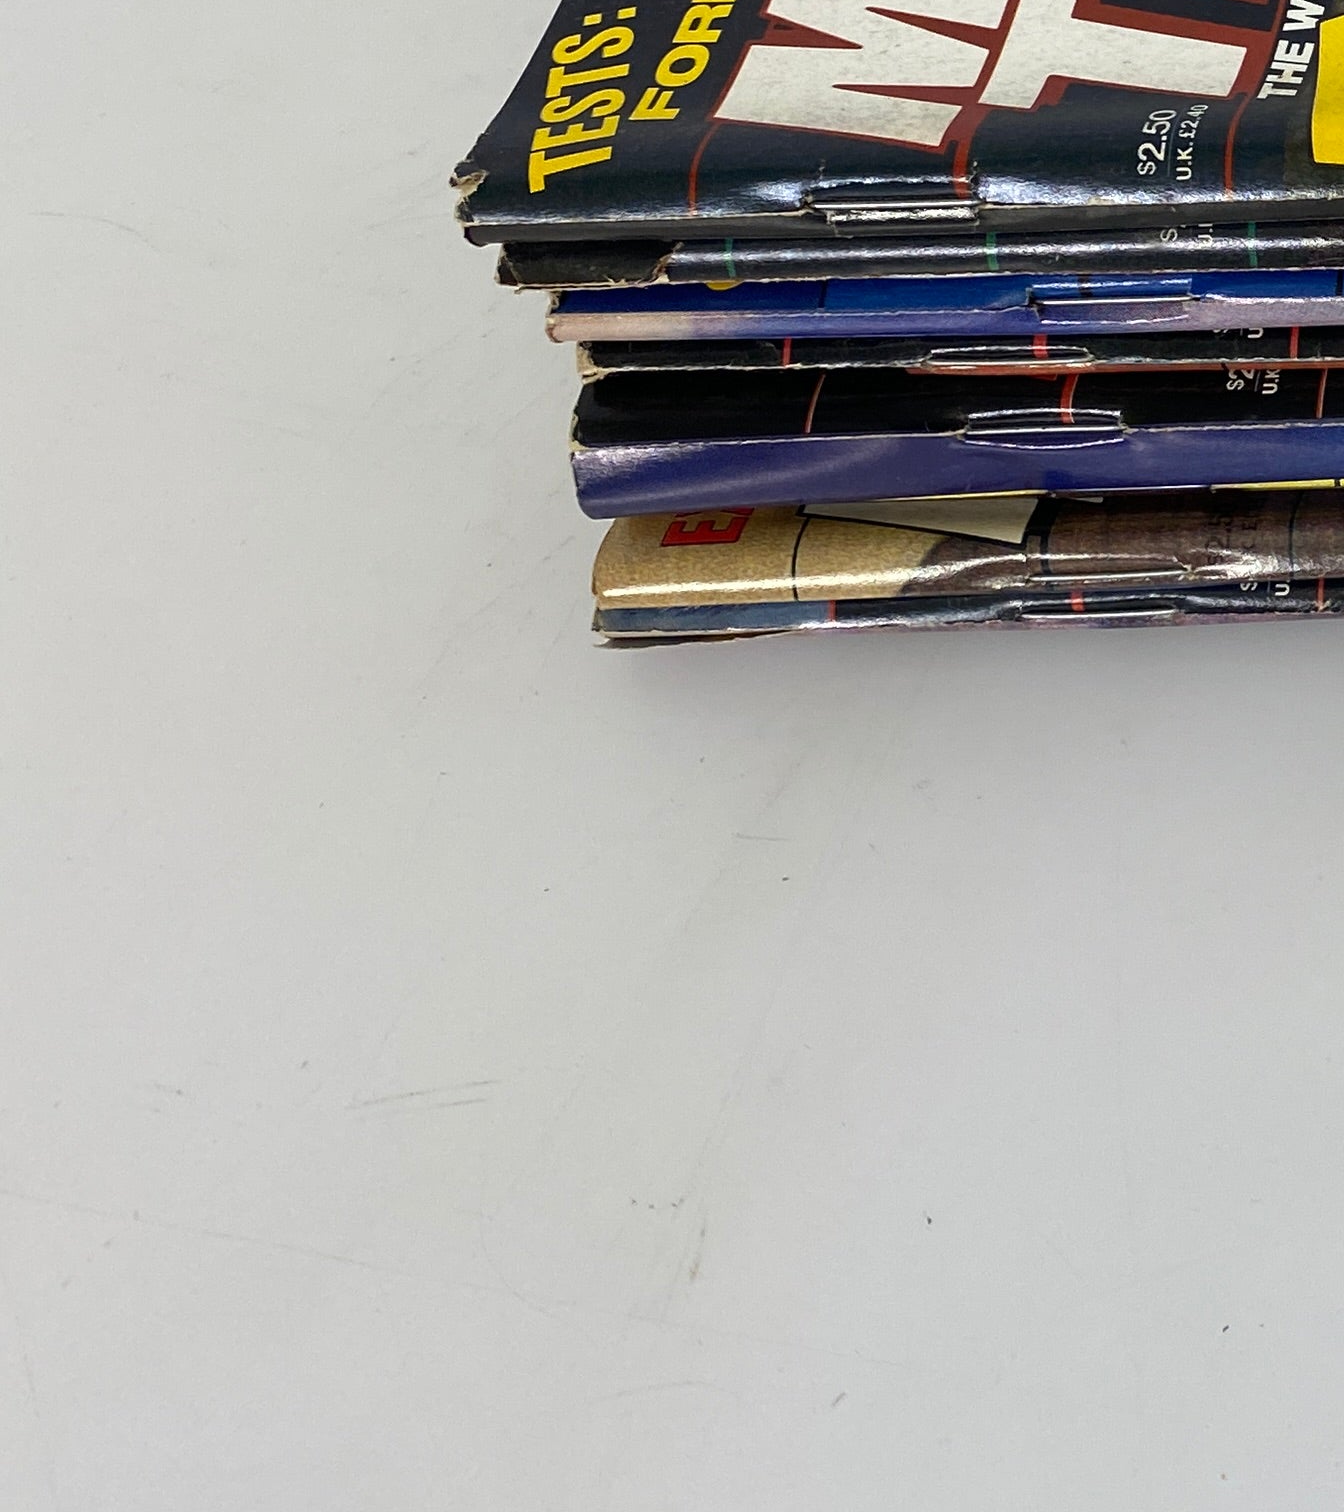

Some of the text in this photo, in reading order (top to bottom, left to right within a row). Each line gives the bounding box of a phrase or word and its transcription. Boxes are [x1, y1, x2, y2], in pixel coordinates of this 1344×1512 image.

[529, 6, 637, 194] TESTS:
[1256, 39, 1316, 100] THE
[1137, 109, 1177, 176] $2.50
